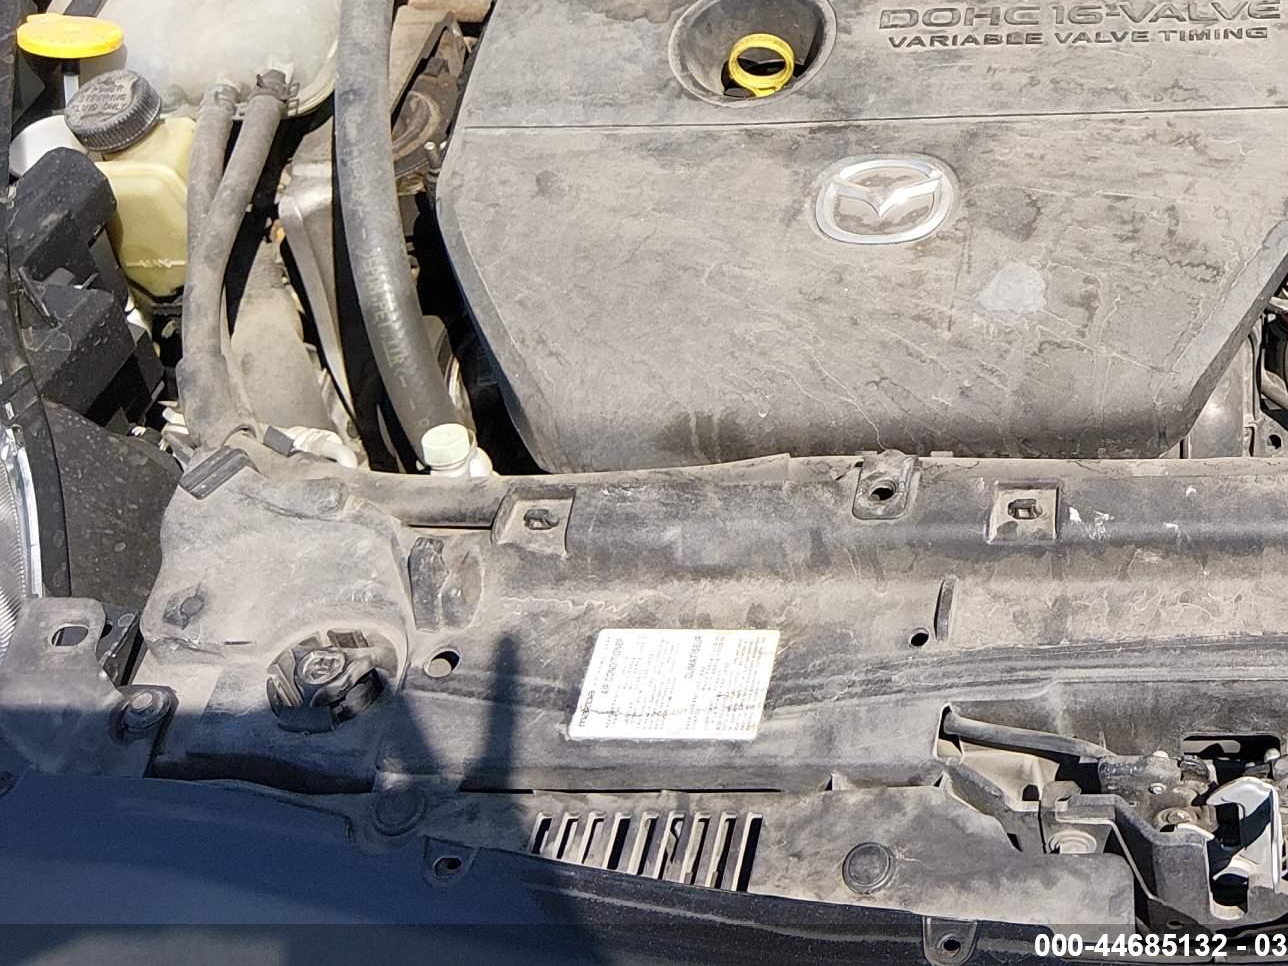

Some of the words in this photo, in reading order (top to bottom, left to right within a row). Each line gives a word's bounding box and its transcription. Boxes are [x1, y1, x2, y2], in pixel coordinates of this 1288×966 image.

[879, 5, 1041, 30] DOHC
[887, 31, 1044, 49] VARIABLE
[1054, 29, 1150, 45] VALVE
[1157, 26, 1269, 42] TIMING
